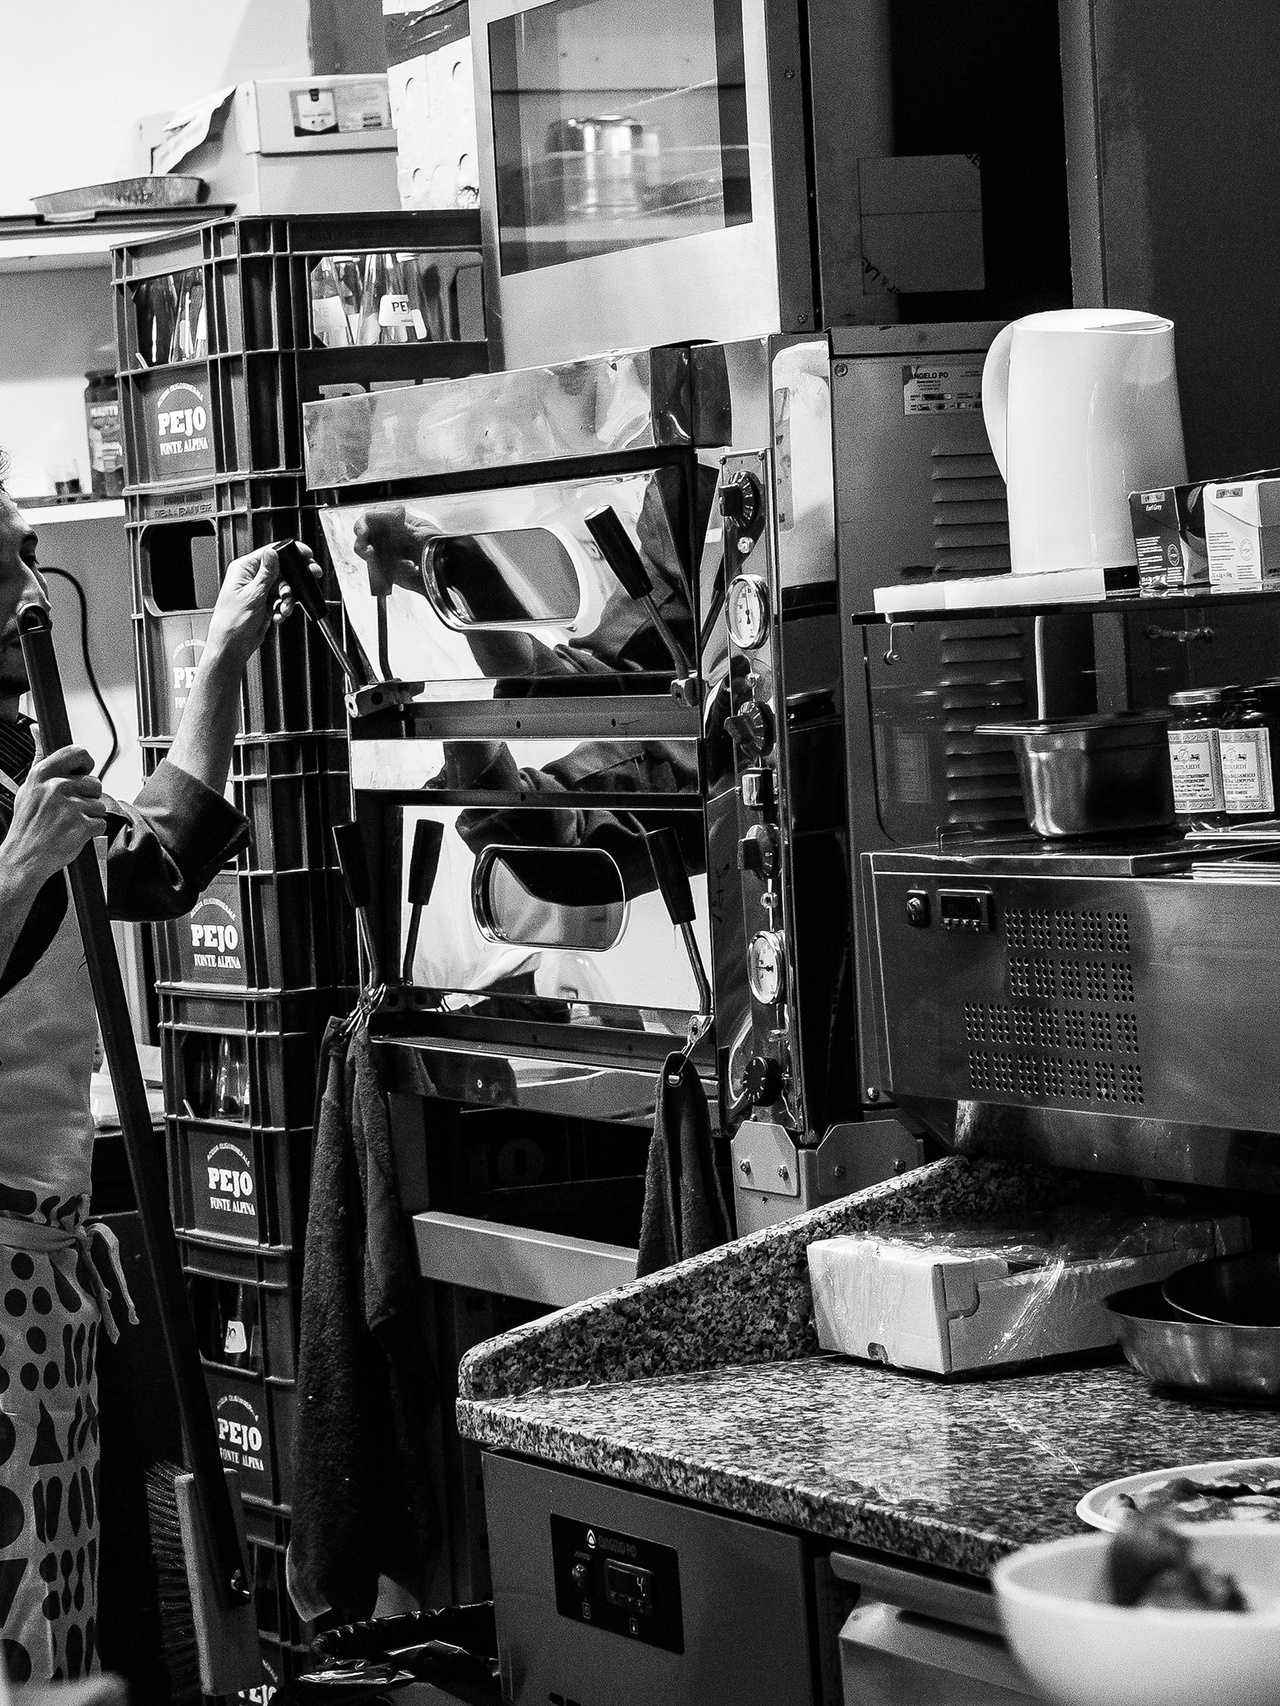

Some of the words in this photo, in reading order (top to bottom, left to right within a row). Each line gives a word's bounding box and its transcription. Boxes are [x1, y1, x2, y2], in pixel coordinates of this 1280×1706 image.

[391, 300, 410, 314] PE
[158, 406, 207, 437] PEJO
[160, 441, 183, 456] FONTE
[184, 437, 208, 452] ALPINA
[173, 667, 198, 689] PE
[191, 924, 239, 953] PEJO
[193, 953, 217, 967] FONTE
[217, 955, 241, 969] ALPINA
[207, 1167, 253, 1198] PEJO
[210, 1196, 232, 1211] FONTE
[232, 1200, 256, 1216] ALPINA
[217, 1418, 262, 1451] PEJO
[242, 1454, 264, 1471] ALPINA
